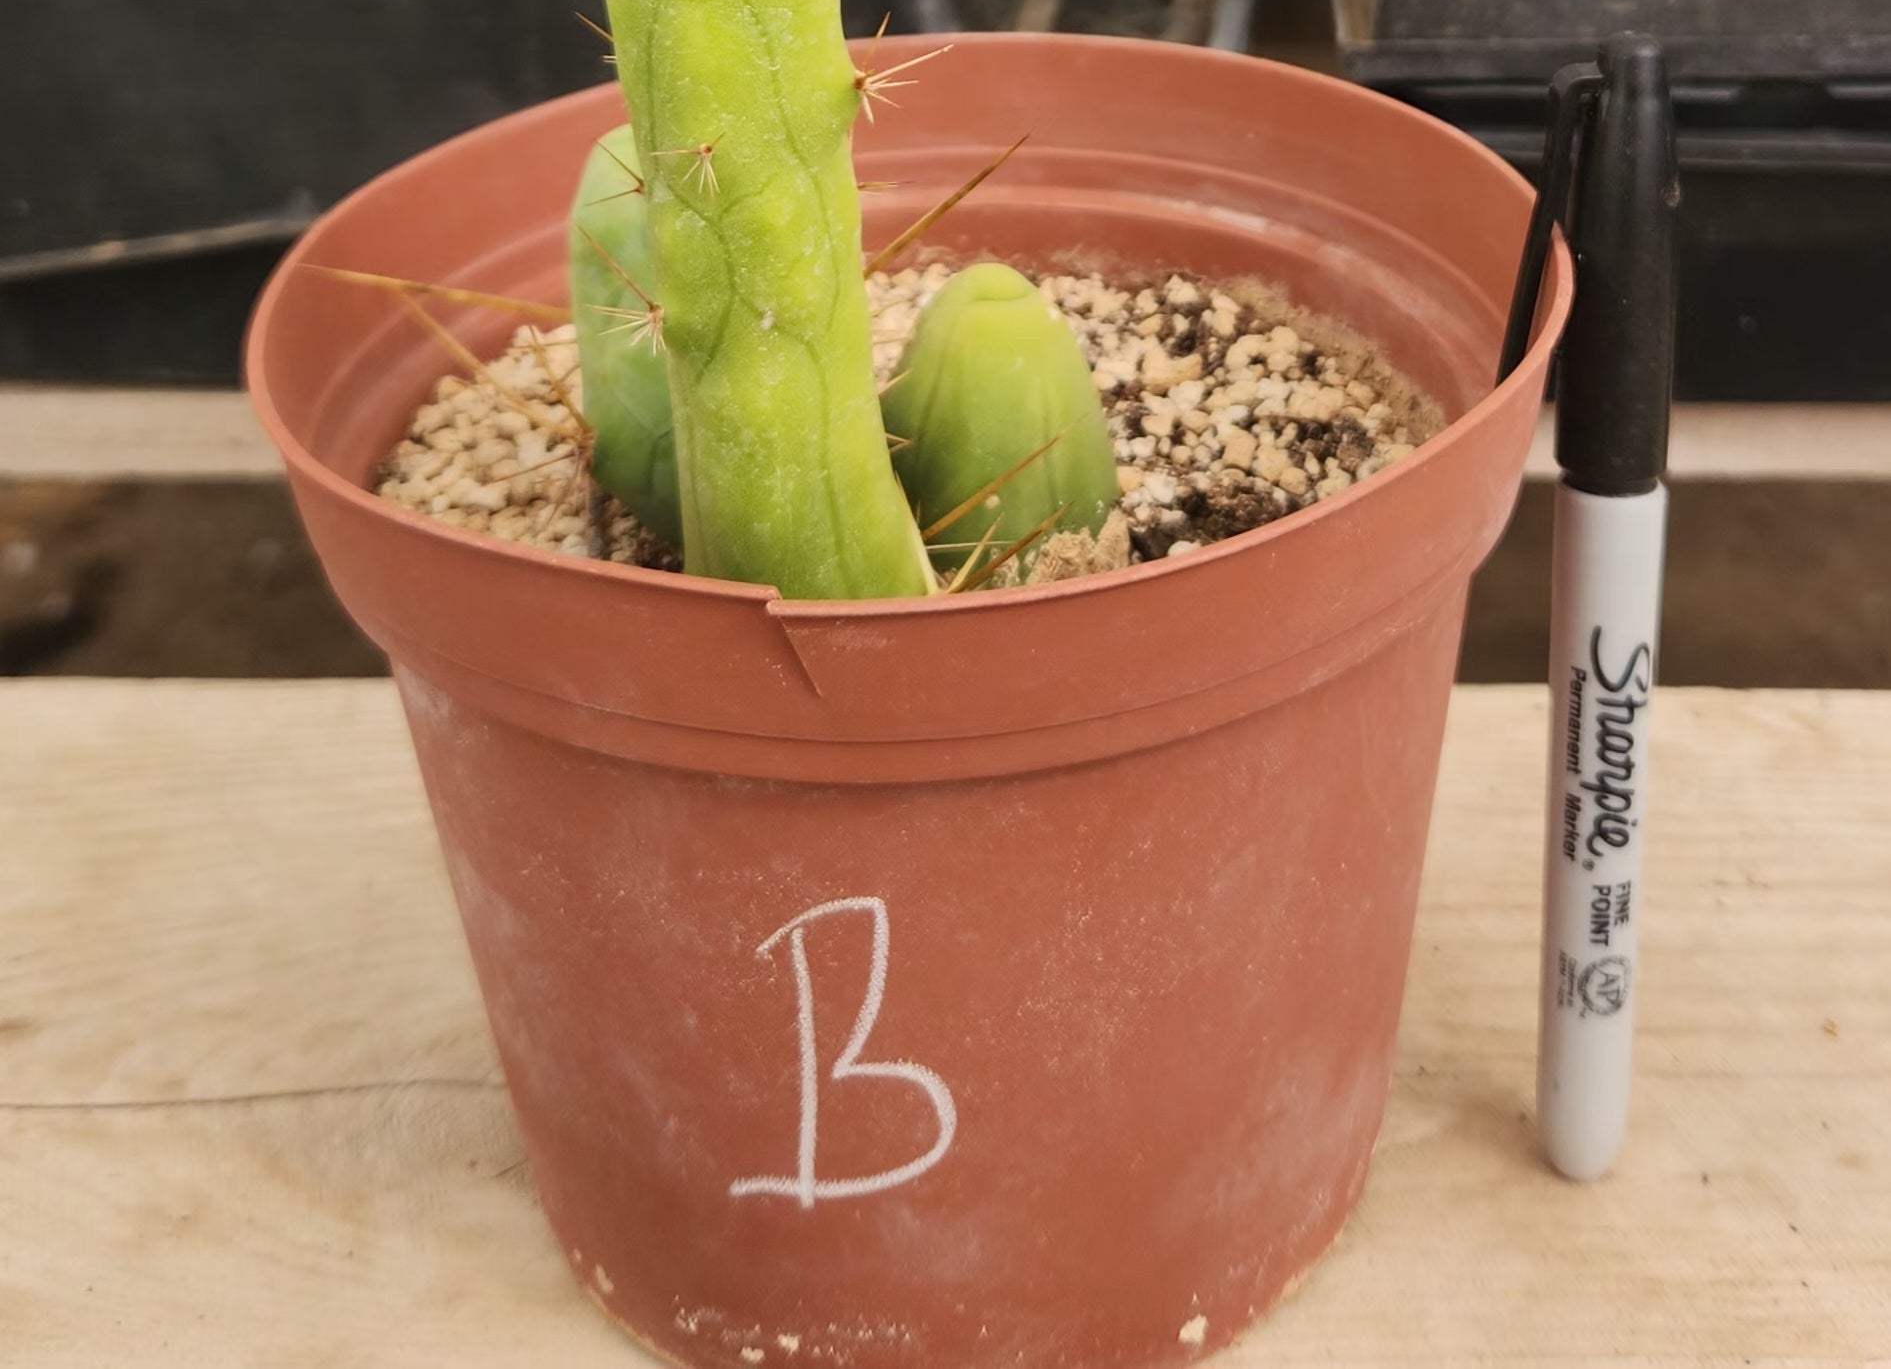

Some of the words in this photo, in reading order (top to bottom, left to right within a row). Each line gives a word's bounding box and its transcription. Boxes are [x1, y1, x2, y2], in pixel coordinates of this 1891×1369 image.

[1566, 666, 1587, 774] Permanent
[1580, 626, 1650, 857] Sharpie
[1562, 793, 1582, 861] Marker
[1589, 884, 1611, 947] POINT
[1613, 879, 1632, 927] FINE
[1597, 969, 1621, 1006] AP
[730, 896, 957, 1209] B
